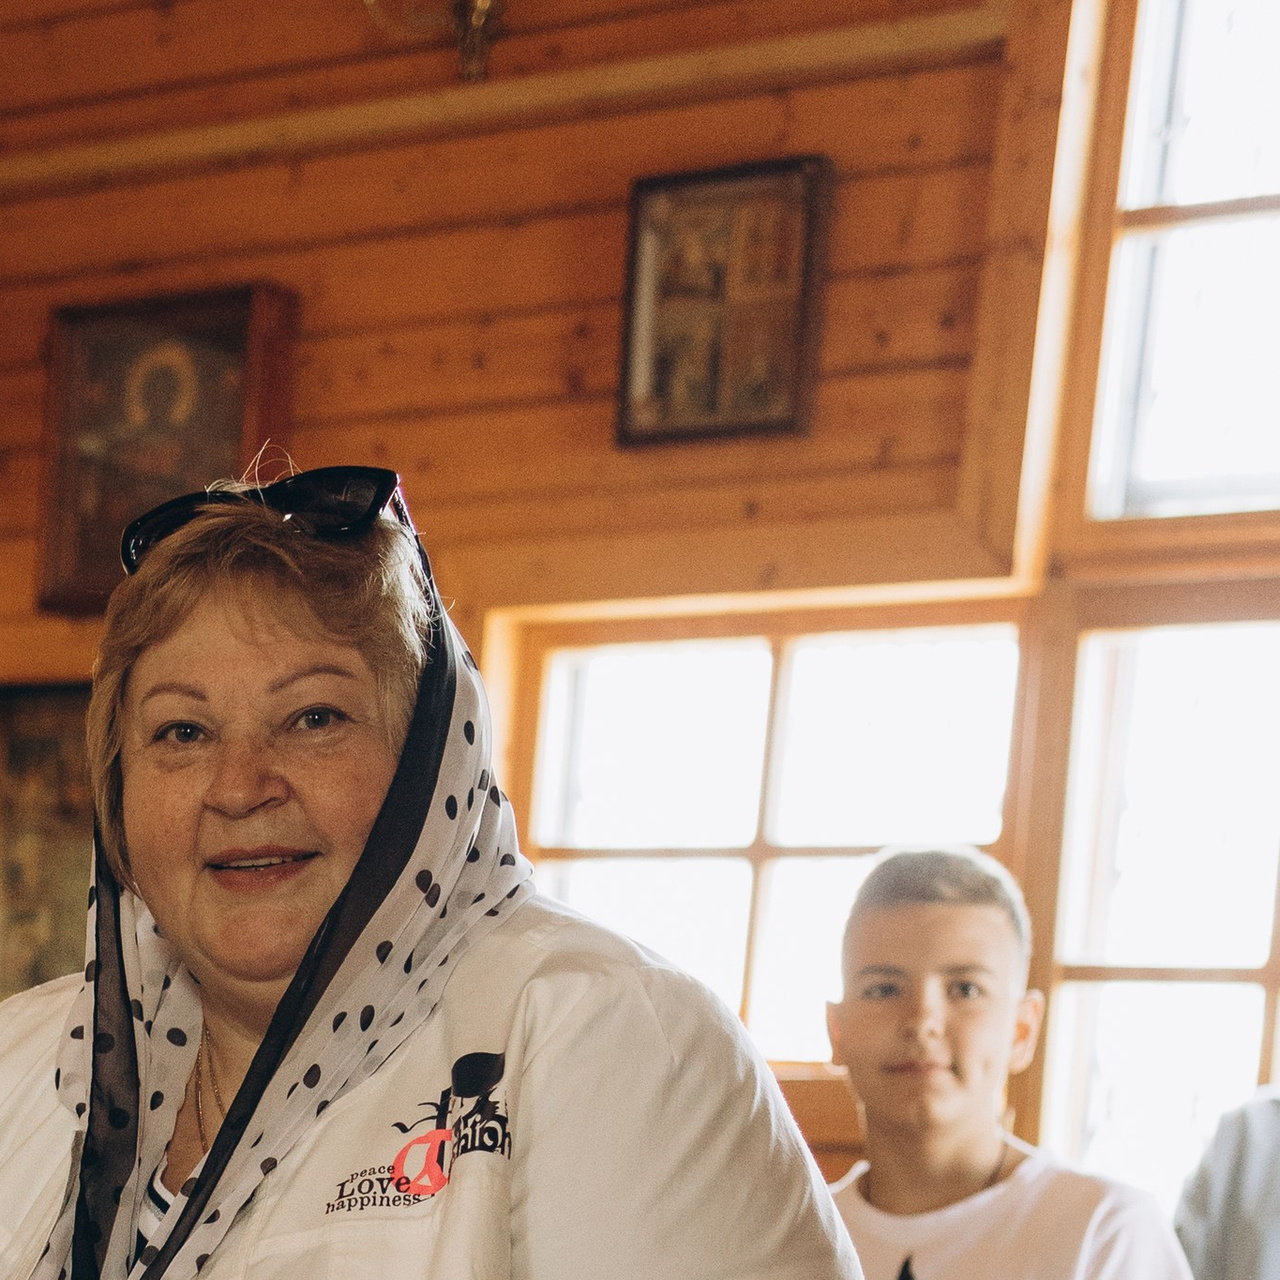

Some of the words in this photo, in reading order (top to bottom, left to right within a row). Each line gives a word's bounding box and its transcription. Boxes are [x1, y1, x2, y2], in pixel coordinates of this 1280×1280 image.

[349, 1164, 396, 1184] peace
[335, 1175, 411, 1201] Love
[325, 1191, 422, 1214] happiness
